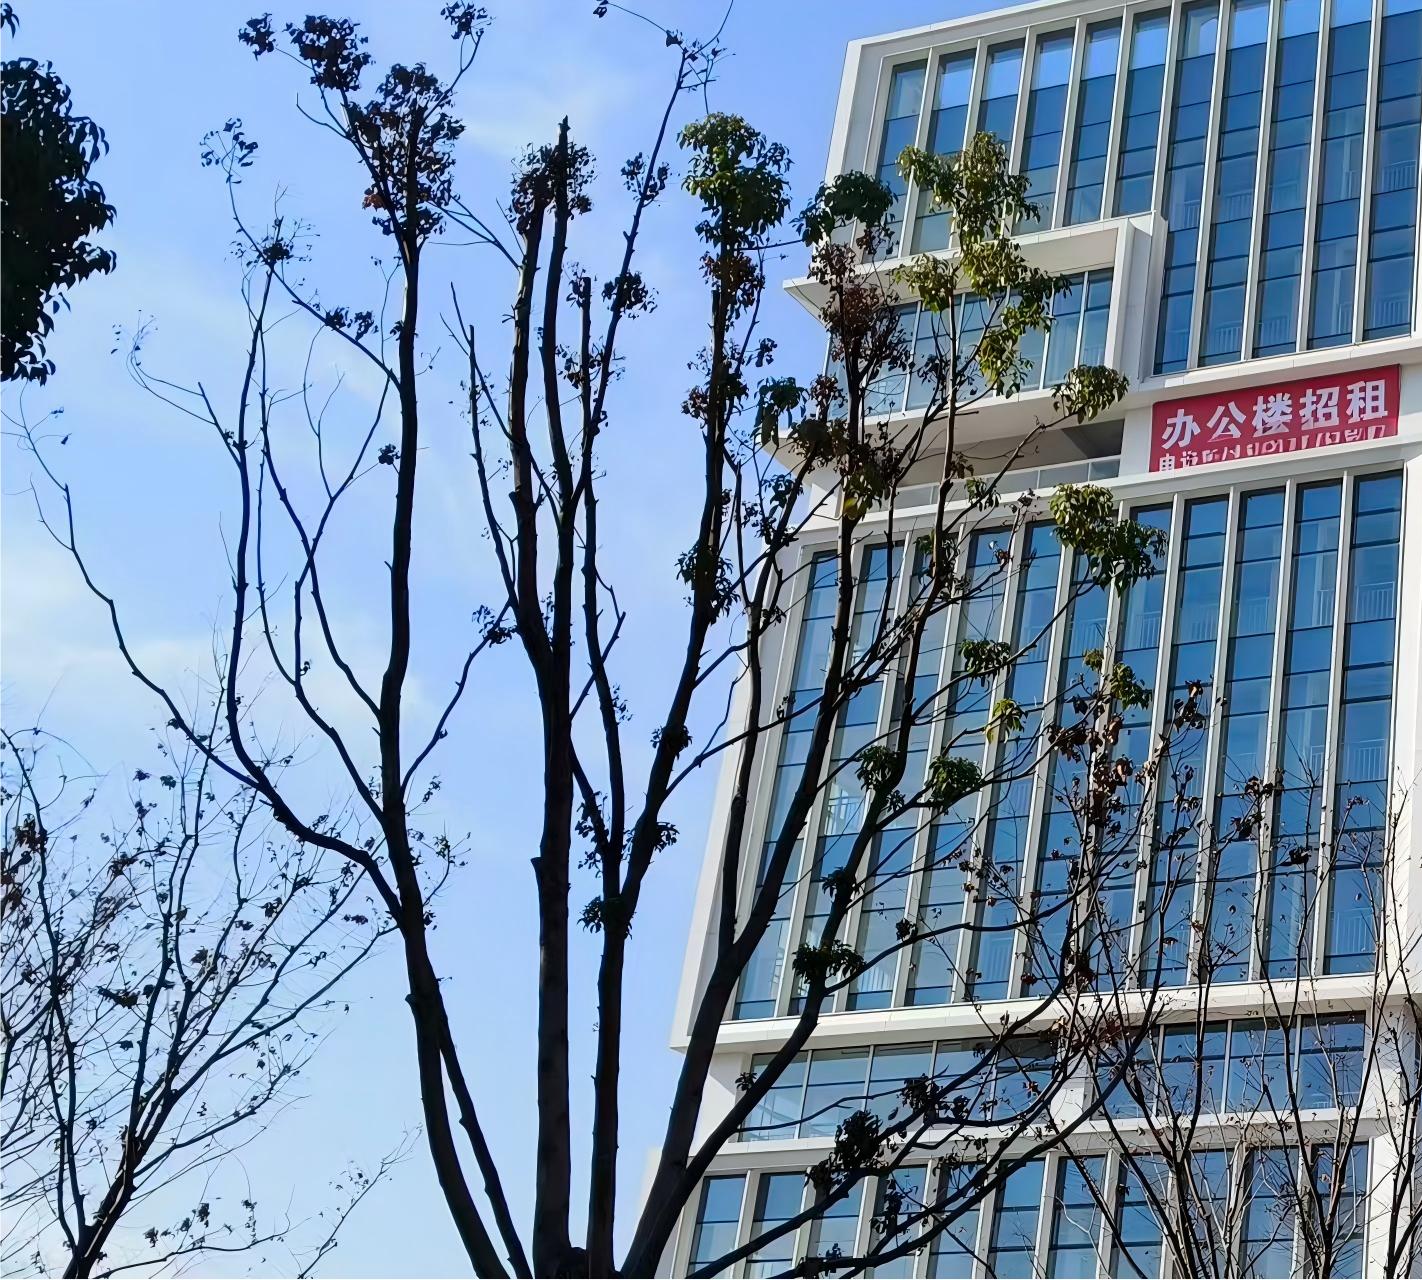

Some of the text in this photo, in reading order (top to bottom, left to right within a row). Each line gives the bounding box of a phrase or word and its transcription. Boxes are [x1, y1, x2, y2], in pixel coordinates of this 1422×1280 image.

[1161, 379, 1389, 450] 办公楼招租
